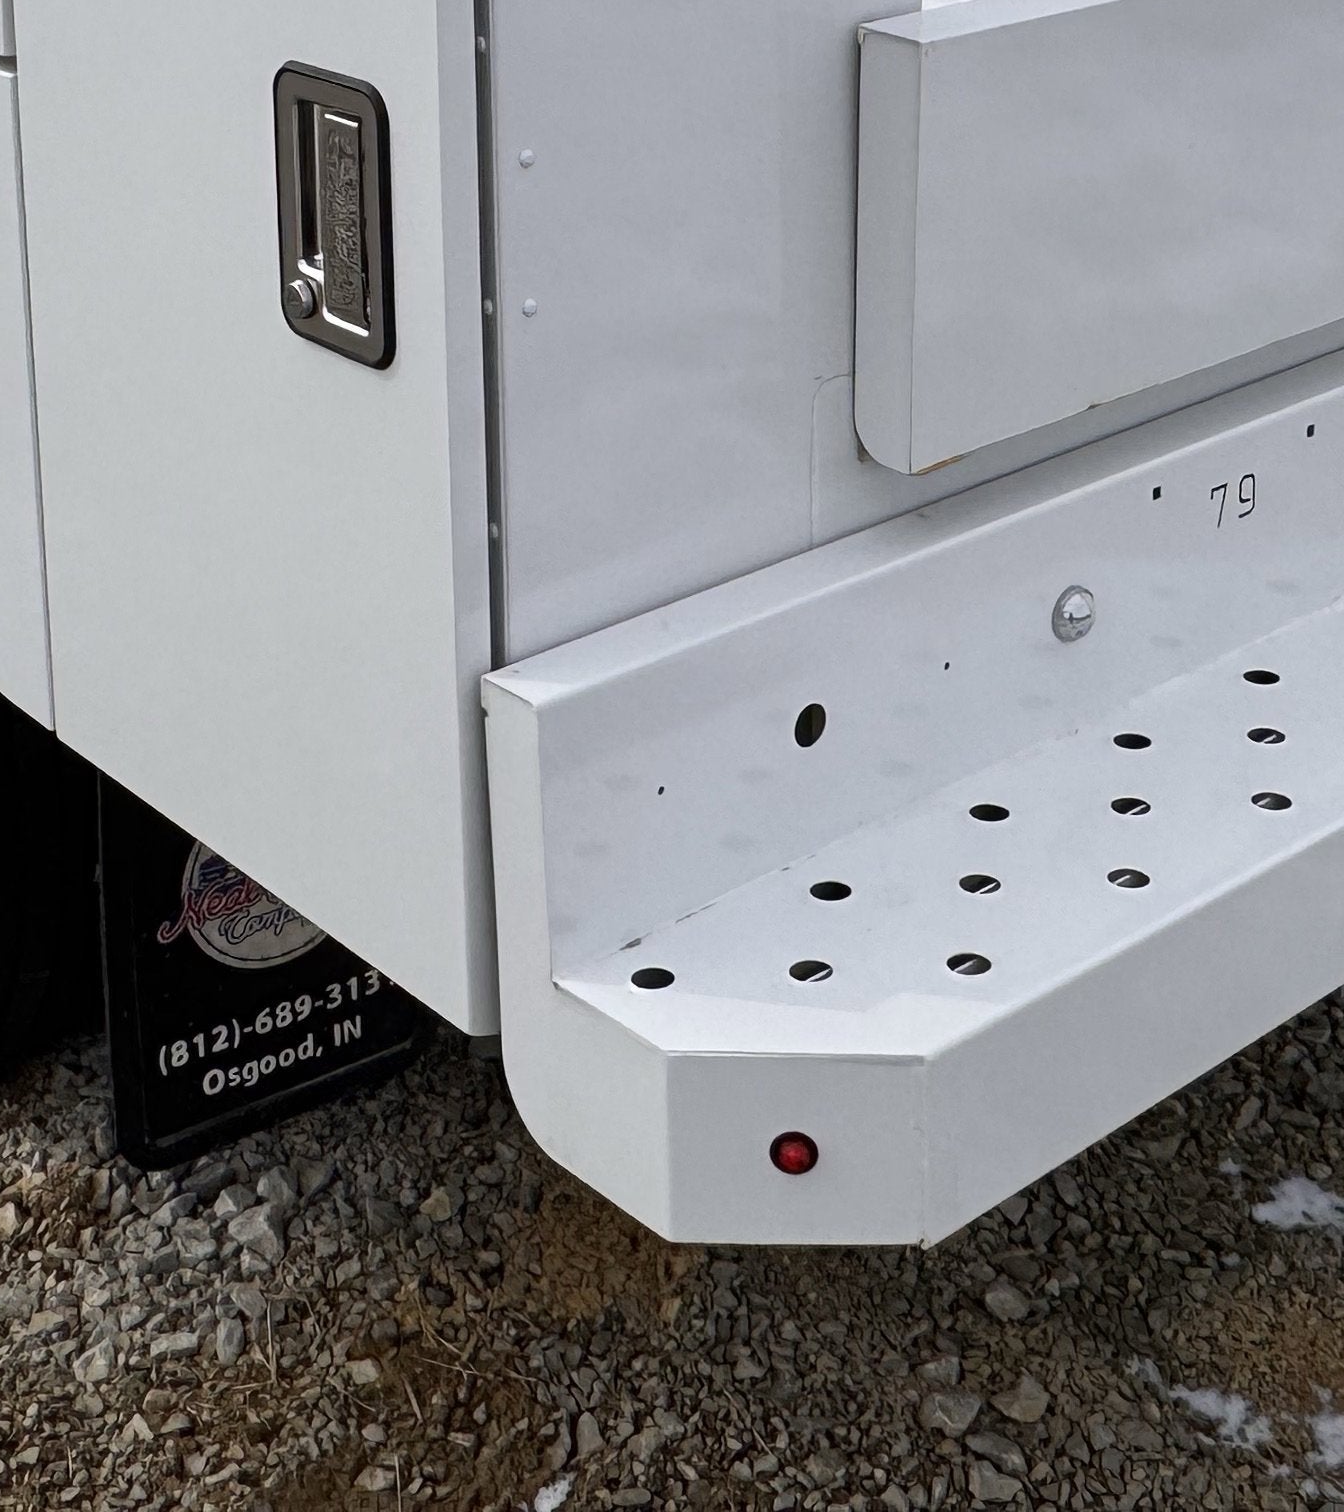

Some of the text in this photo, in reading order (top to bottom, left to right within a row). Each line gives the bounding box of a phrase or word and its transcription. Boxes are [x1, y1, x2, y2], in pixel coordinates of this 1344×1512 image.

[1210, 473, 1256, 528] 79
[159, 969, 394, 1076] (812)-689-313
[202, 1015, 362, 1096] Osgood, IN
